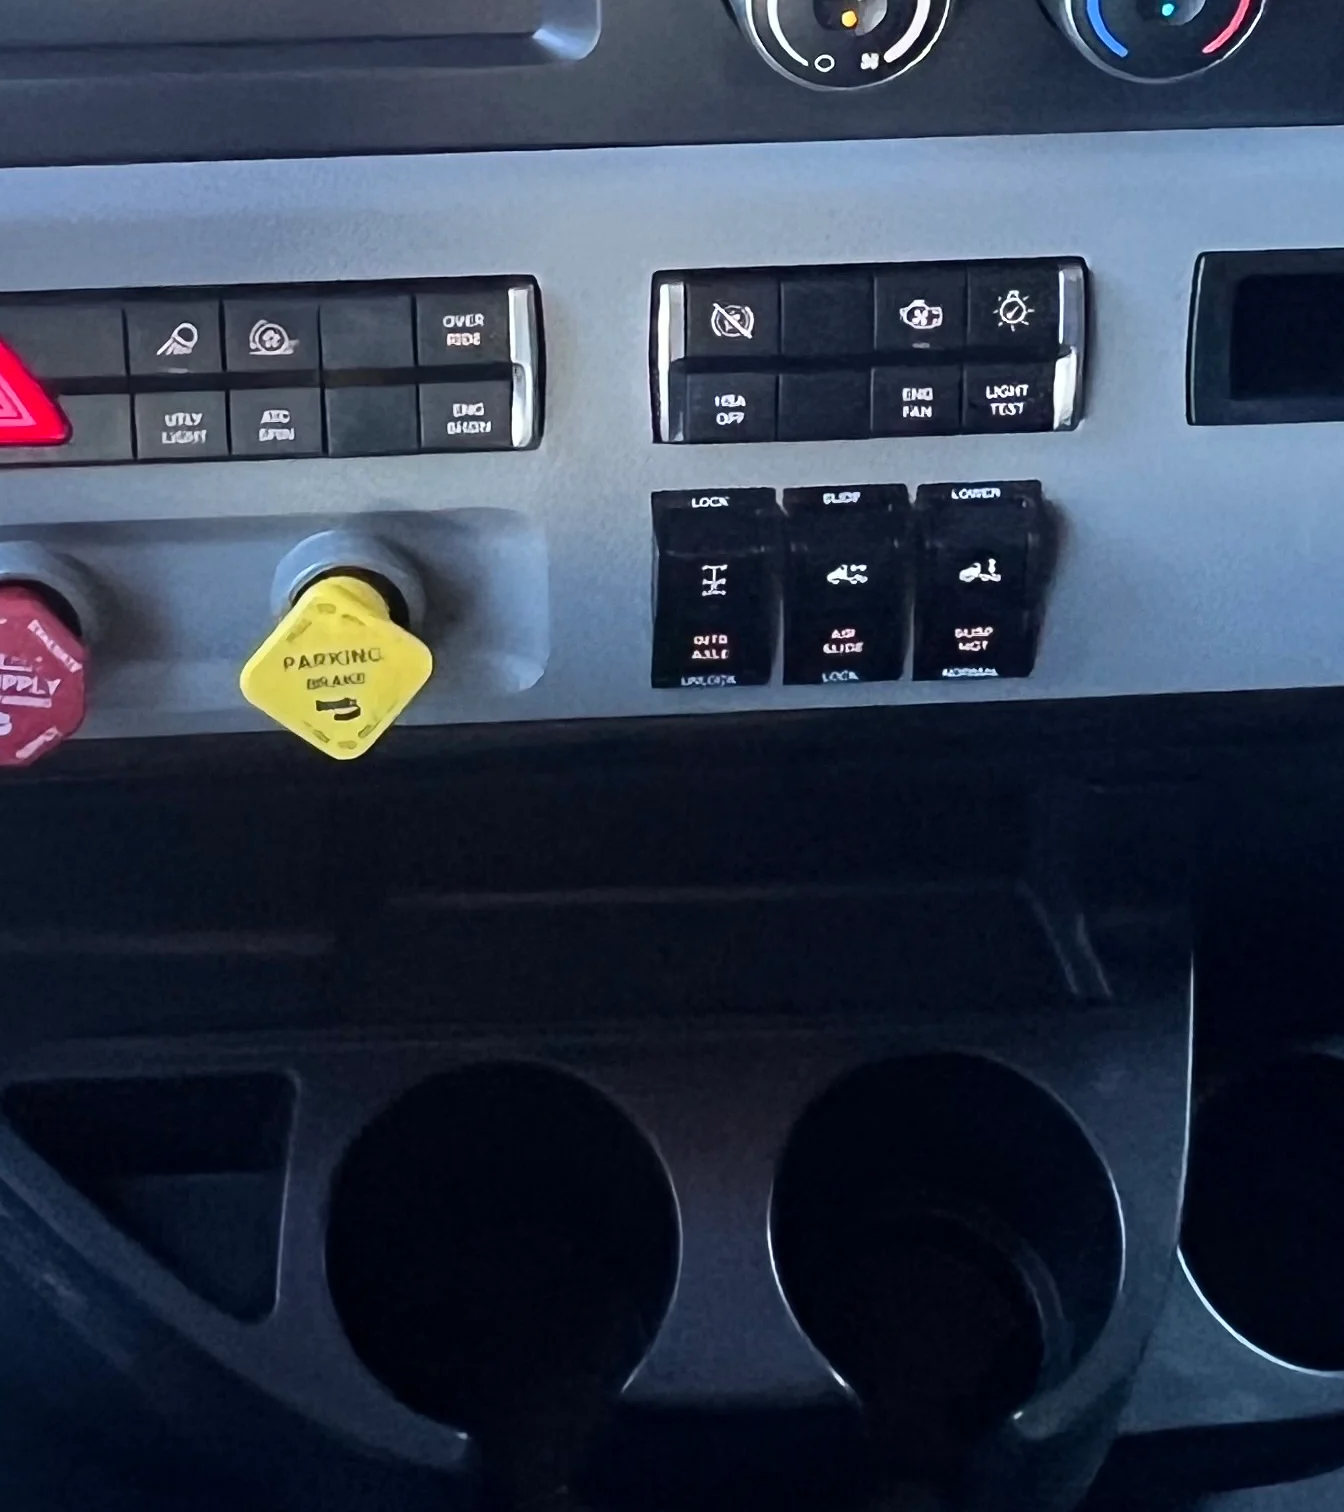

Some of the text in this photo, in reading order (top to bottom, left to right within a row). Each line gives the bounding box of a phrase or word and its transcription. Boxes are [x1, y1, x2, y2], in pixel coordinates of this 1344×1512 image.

[442, 312, 485, 329] OVER
[985, 384, 1029, 399] LIGHT
[902, 405, 933, 418] FAN
[990, 402, 1025, 416] TEST
[716, 411, 745, 426] OFF
[161, 429, 207, 444] LIGHT
[691, 495, 730, 508] LOCK
[283, 646, 383, 673] PARKING
[306, 672, 366, 690] BRAKE
